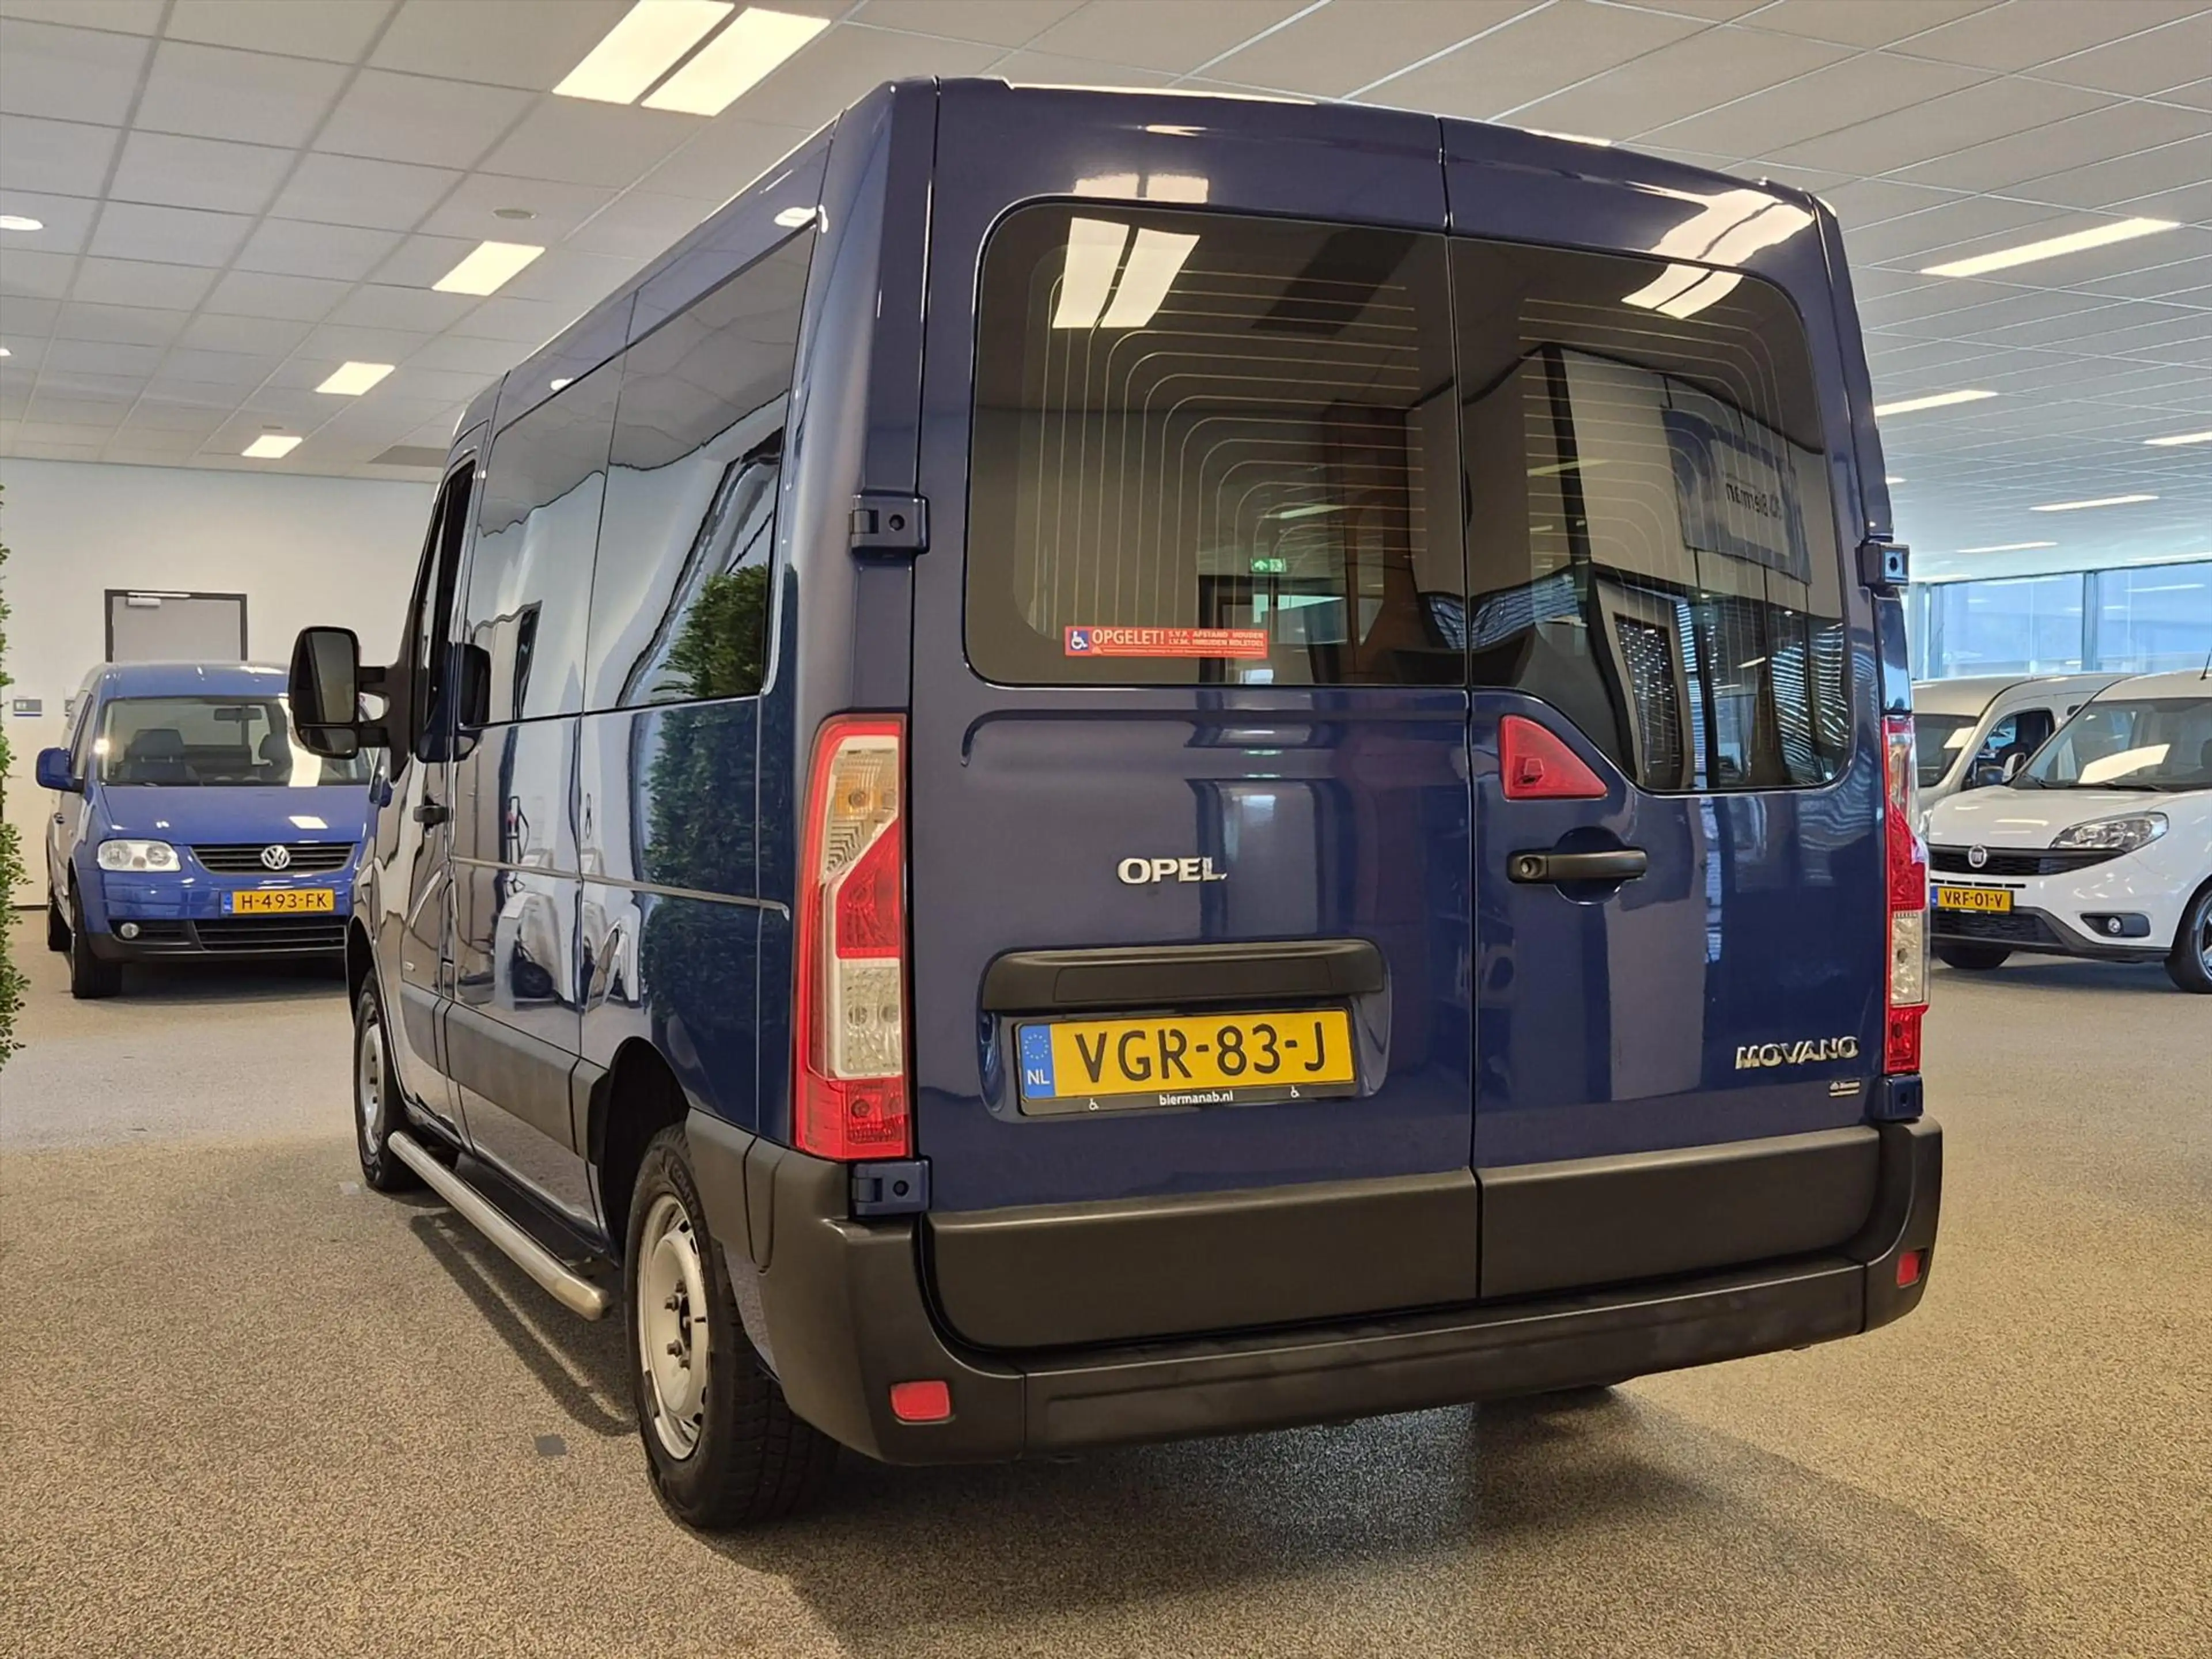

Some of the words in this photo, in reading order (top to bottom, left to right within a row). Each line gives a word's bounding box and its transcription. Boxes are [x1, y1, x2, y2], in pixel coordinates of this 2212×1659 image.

[1092, 630, 1164, 645] OPGELET!
[1117, 857, 1228, 884] OPEL
[241, 893, 327, 910] H-493-FK
[1944, 891, 2003, 908] VRF-01-V
[1075, 1021, 1325, 1084] VGR-83-J
[1734, 1036, 1859, 1070] MOVANO
[1027, 1069, 1050, 1085] NL
[1159, 1090, 1233, 1105] biermanab.nl
